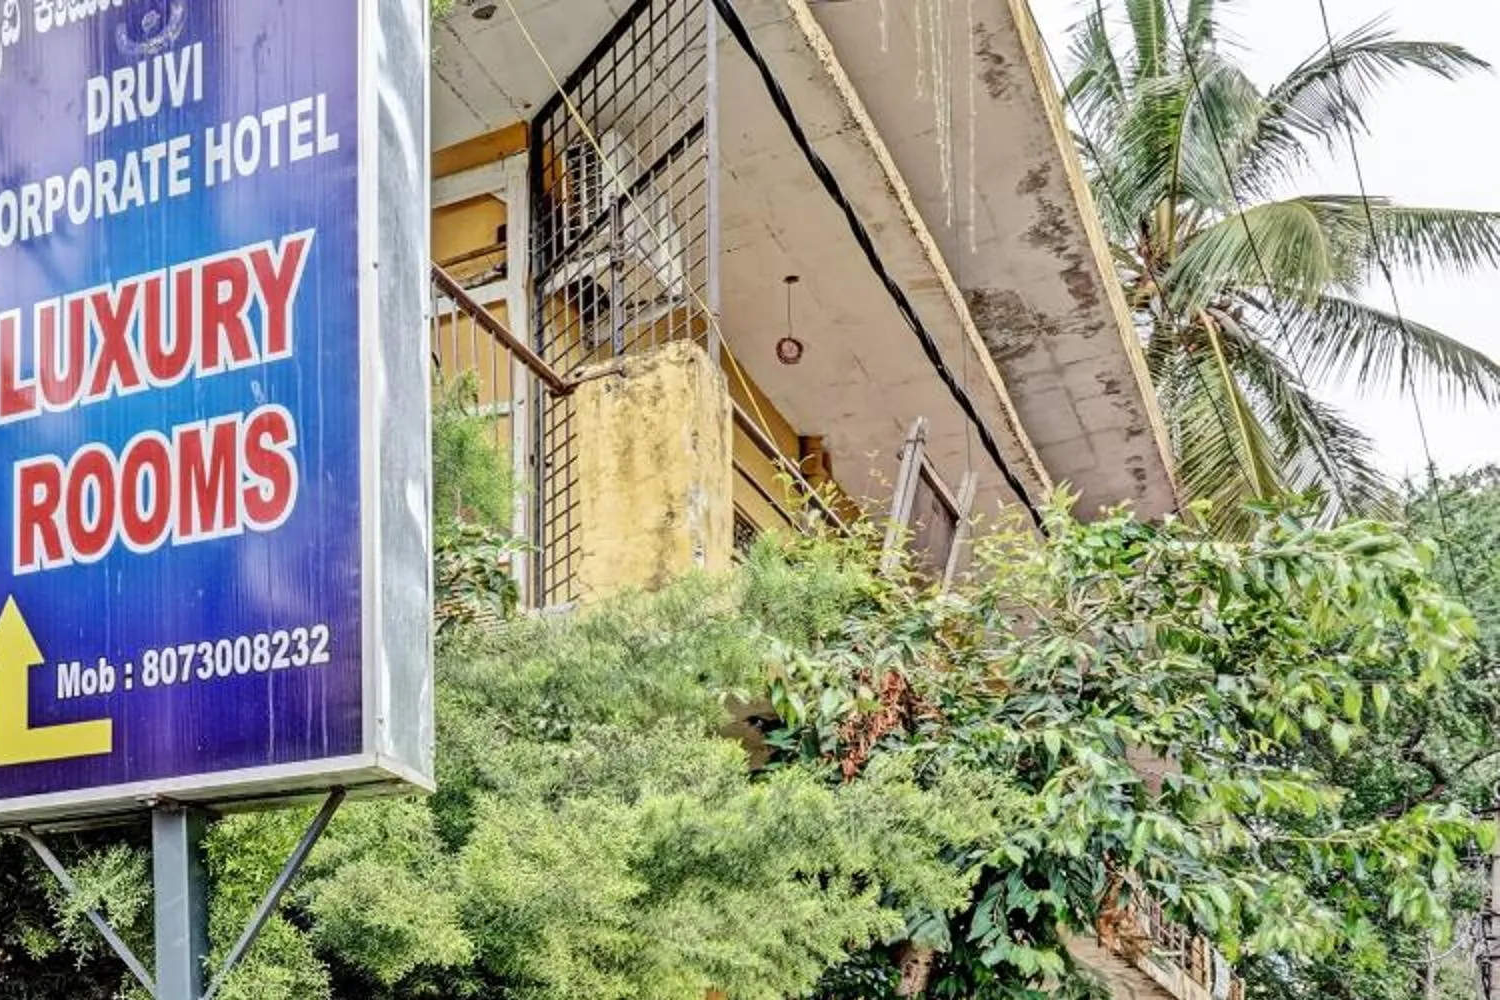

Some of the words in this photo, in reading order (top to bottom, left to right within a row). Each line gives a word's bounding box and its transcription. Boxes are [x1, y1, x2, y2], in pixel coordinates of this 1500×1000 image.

[86, 41, 203, 136] DRUVI
[204, 93, 340, 188] HOTEL
[12, 403, 298, 576] ROOMS
[56, 656, 115, 700] Mob
[141, 623, 331, 688] 8073008232
